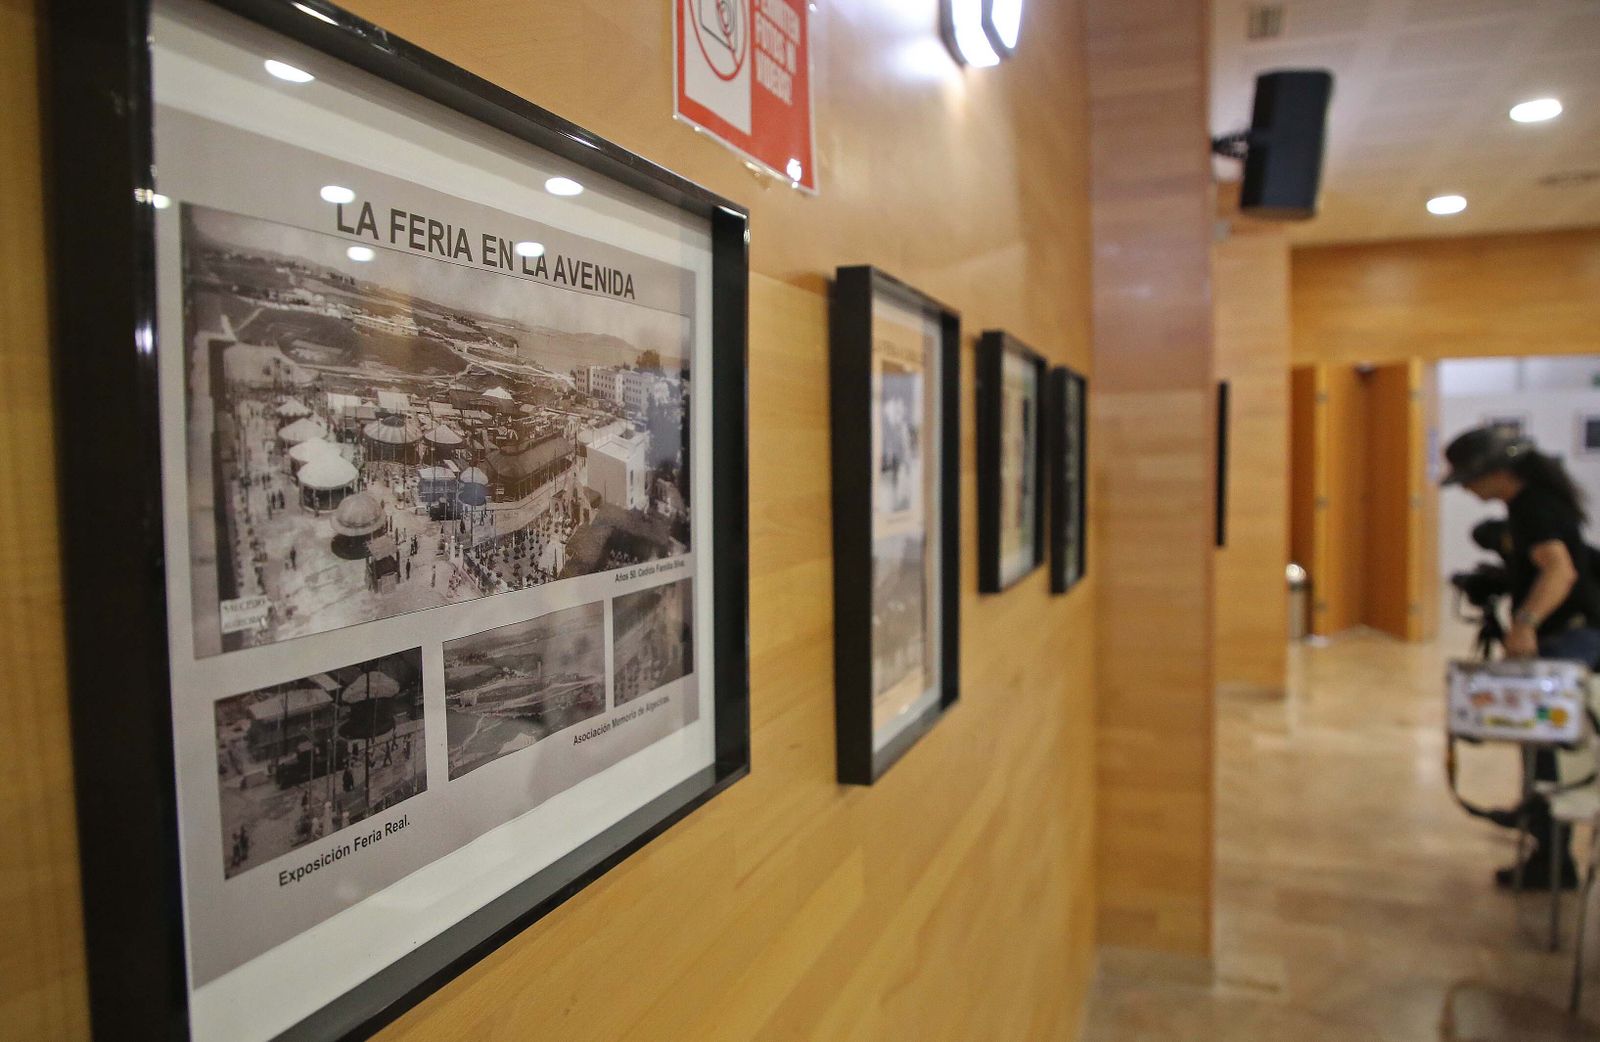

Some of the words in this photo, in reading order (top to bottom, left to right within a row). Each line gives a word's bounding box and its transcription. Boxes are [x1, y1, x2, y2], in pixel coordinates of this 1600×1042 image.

[336, 202, 379, 240] LA
[390, 208, 473, 262] FERIA
[482, 233, 514, 272] EN
[522, 247, 548, 280] LA
[553, 255, 636, 300] AVENIDA
[573, 722, 611, 746] Asociación
[611, 709, 637, 729] Memoria
[278, 845, 351, 887] Exposición
[354, 829, 382, 853] Feria
[385, 813, 410, 837] Real.
